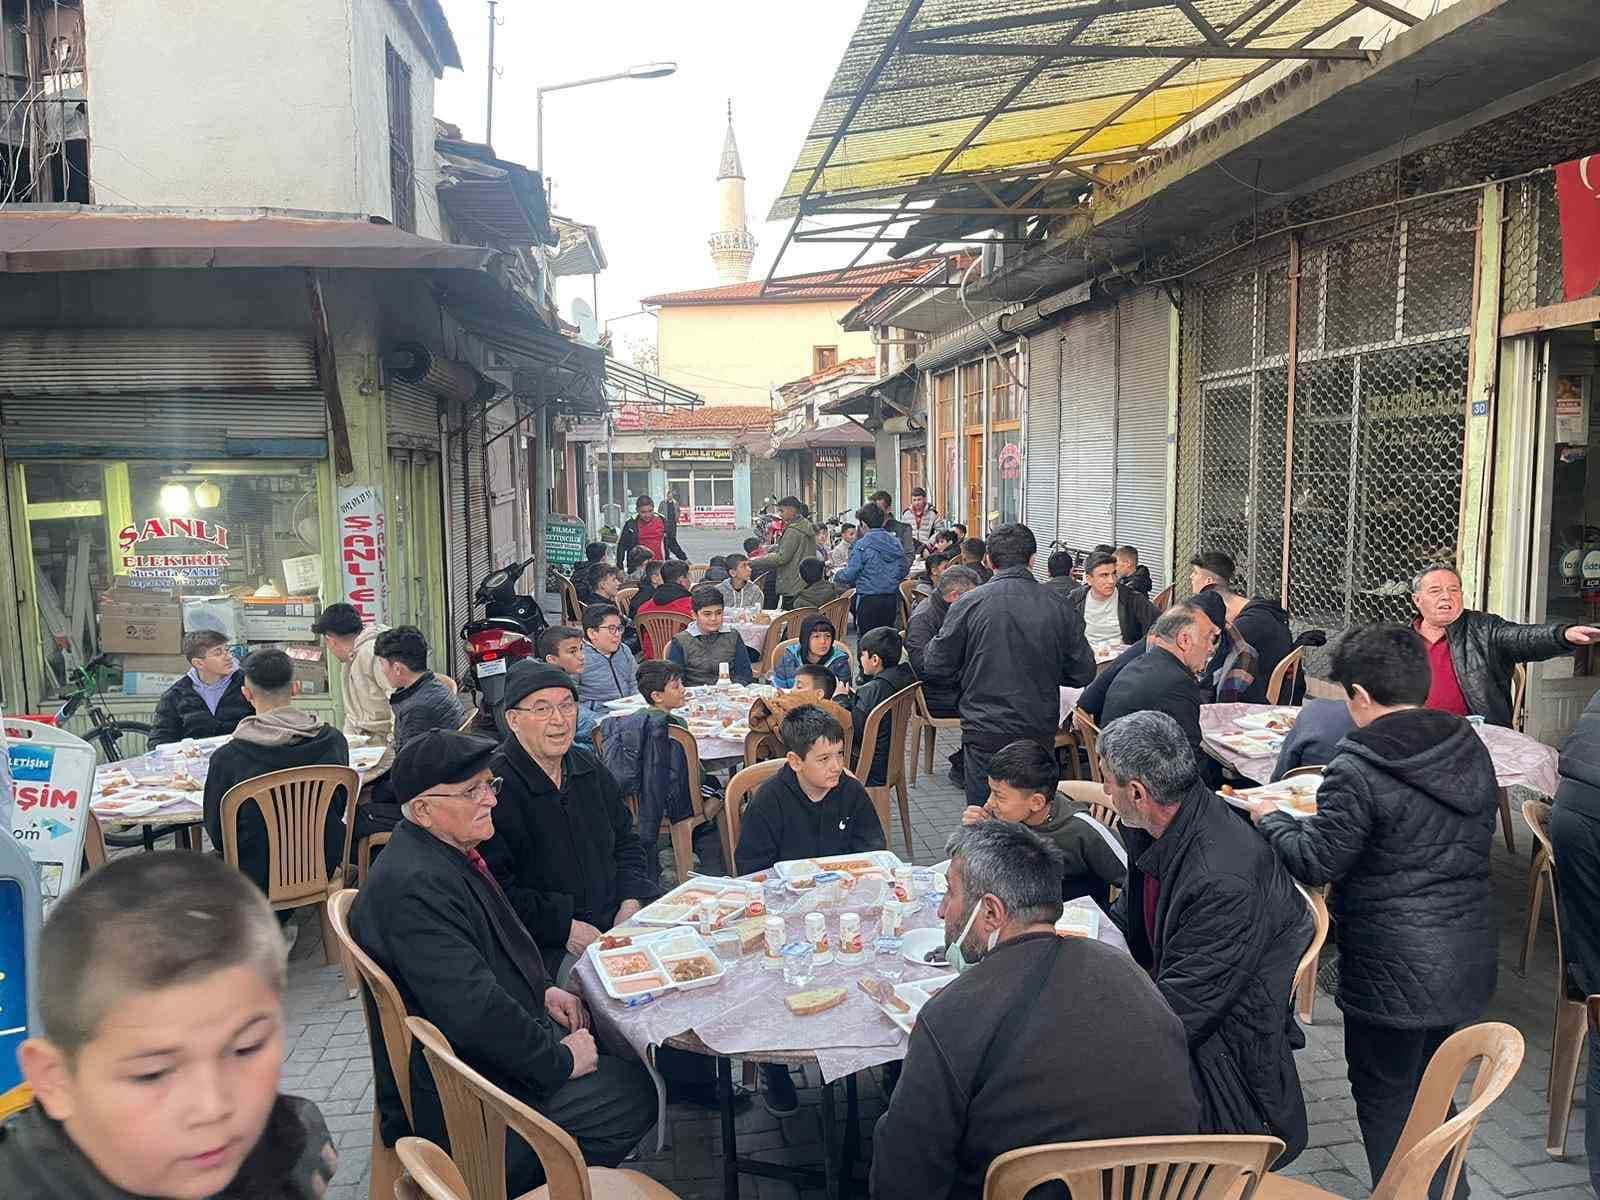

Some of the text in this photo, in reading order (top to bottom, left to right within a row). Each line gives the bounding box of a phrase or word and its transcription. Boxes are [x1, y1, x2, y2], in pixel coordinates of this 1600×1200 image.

[1473, 403, 1486, 414] 30
[118, 517, 229, 552] ŞANLI
[121, 551, 231, 568] ELEKTRİK
[8, 757, 49, 769] LETİŞİM
[12, 829, 40, 840] om
